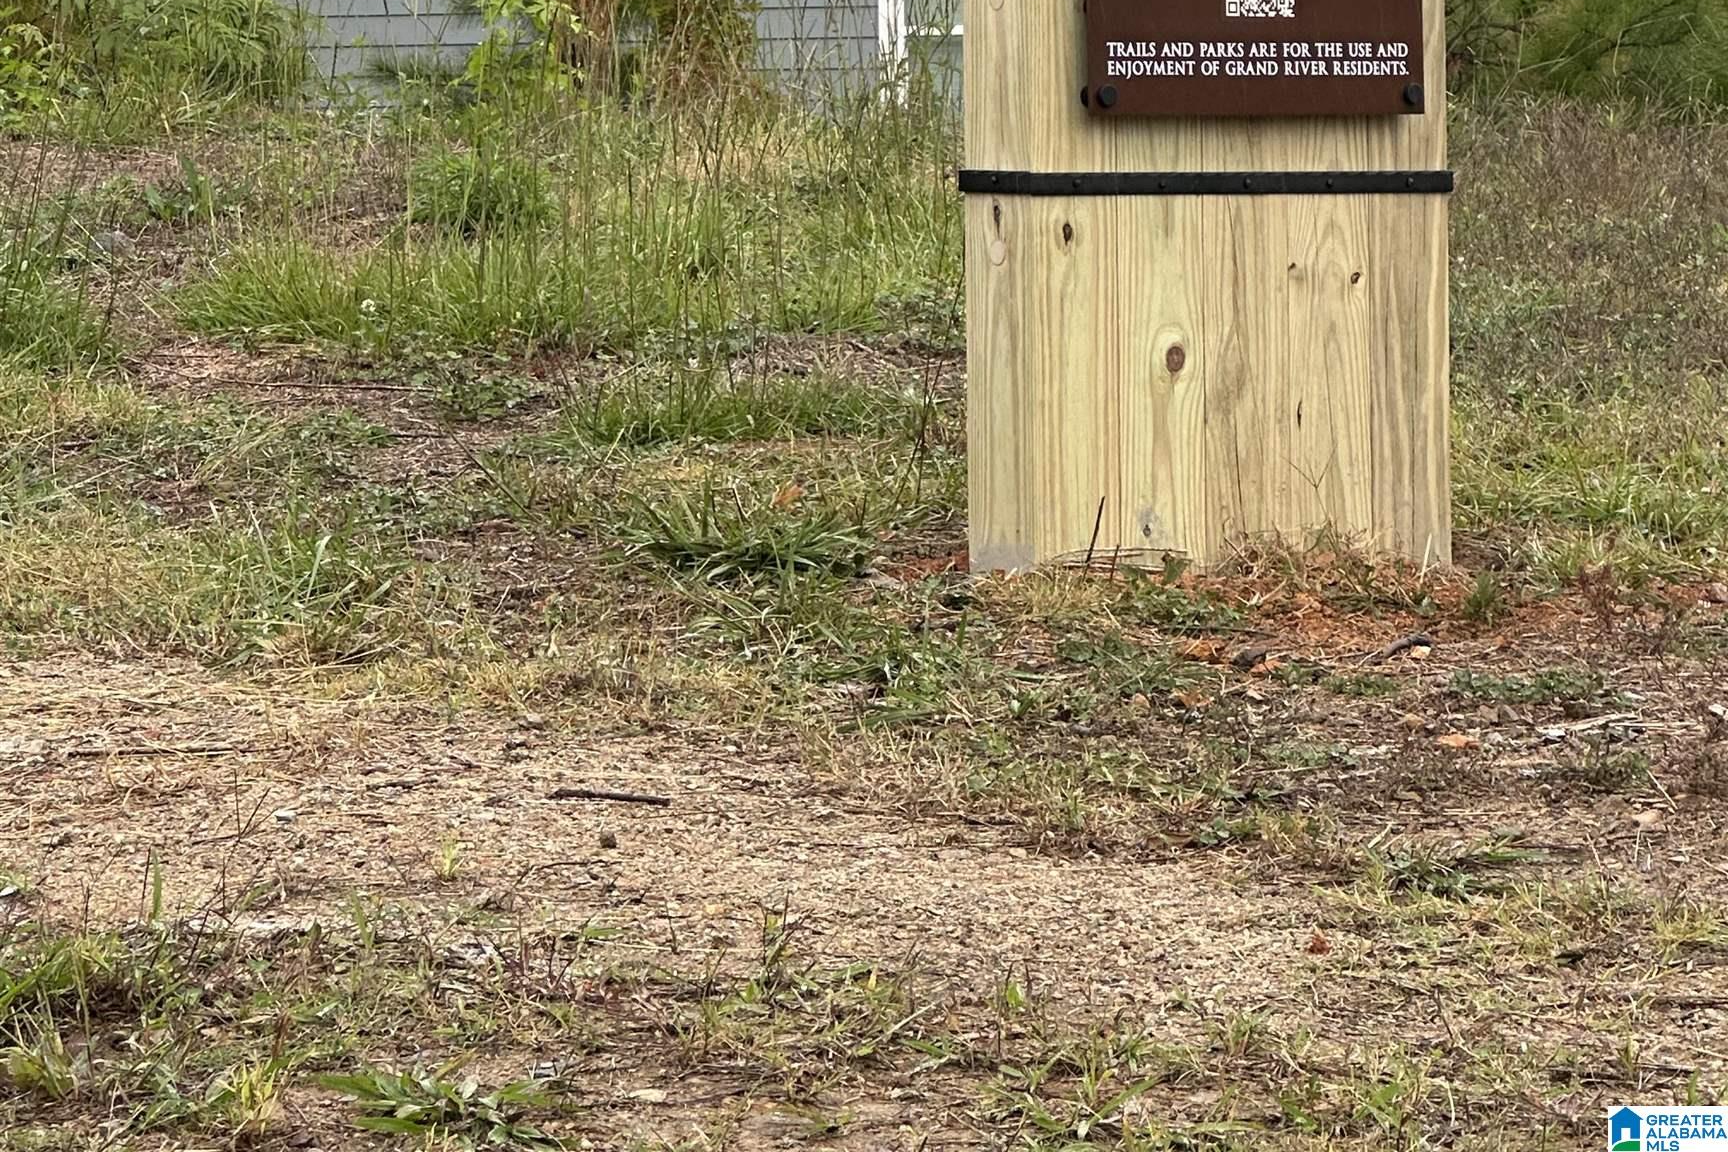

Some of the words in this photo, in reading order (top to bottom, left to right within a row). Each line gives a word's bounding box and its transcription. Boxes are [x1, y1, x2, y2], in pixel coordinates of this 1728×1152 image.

[1106, 42, 1156, 57] TRAILS
[1161, 42, 1194, 57] AND
[1200, 42, 1245, 57] PARKS
[1249, 42, 1277, 57] ARE
[1283, 42, 1312, 58] FOR
[1315, 42, 1343, 57] THE
[1349, 43, 1372, 57] USE
[1377, 43, 1409, 57] AND
[1107, 61, 1196, 79] ENJOYMENT
[1201, 61, 1220, 76] OF
[1226, 61, 1278, 76] GRAND
[1284, 61, 1328, 76] RIVER
[1333, 61, 1409, 76] RESIDENTS.
